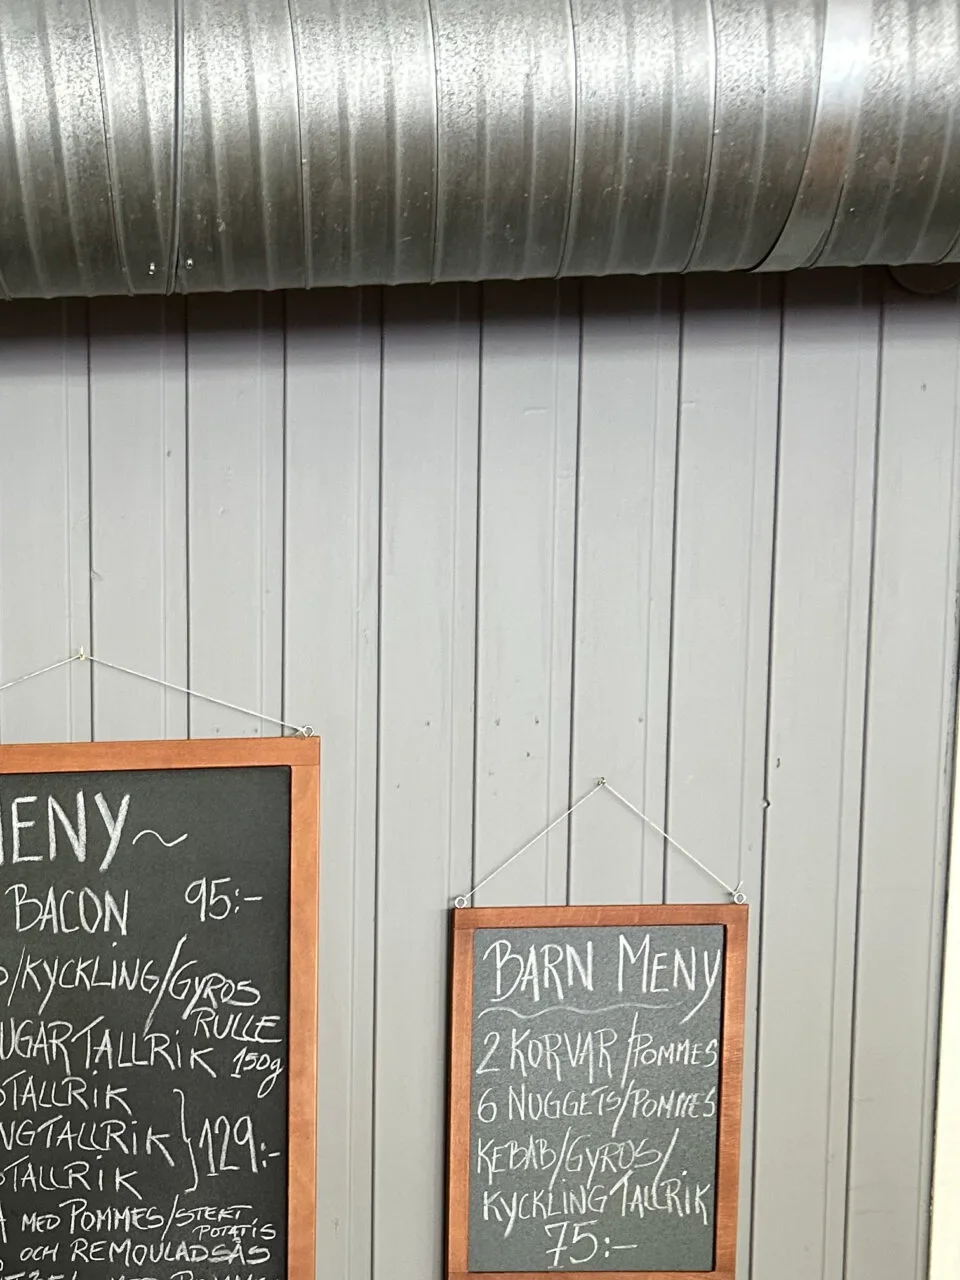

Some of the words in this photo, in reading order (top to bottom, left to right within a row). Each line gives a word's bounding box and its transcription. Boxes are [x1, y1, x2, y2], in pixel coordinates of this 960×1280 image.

[5, 883, 129, 935] BACON
[184, 877, 263, 922] 95:-
[483, 939, 594, 1002] BARN
[619, 934, 721, 1025] MENY
[190, 1007, 283, 1043] RULLE
[476, 1032, 500, 1074] 2
[477, 1087, 498, 1123] 6
[21, 1211, 61, 1234] MED
[19, 1242, 58, 1263] OCH
[70, 1234, 270, 1267] REMOULADSÅS
